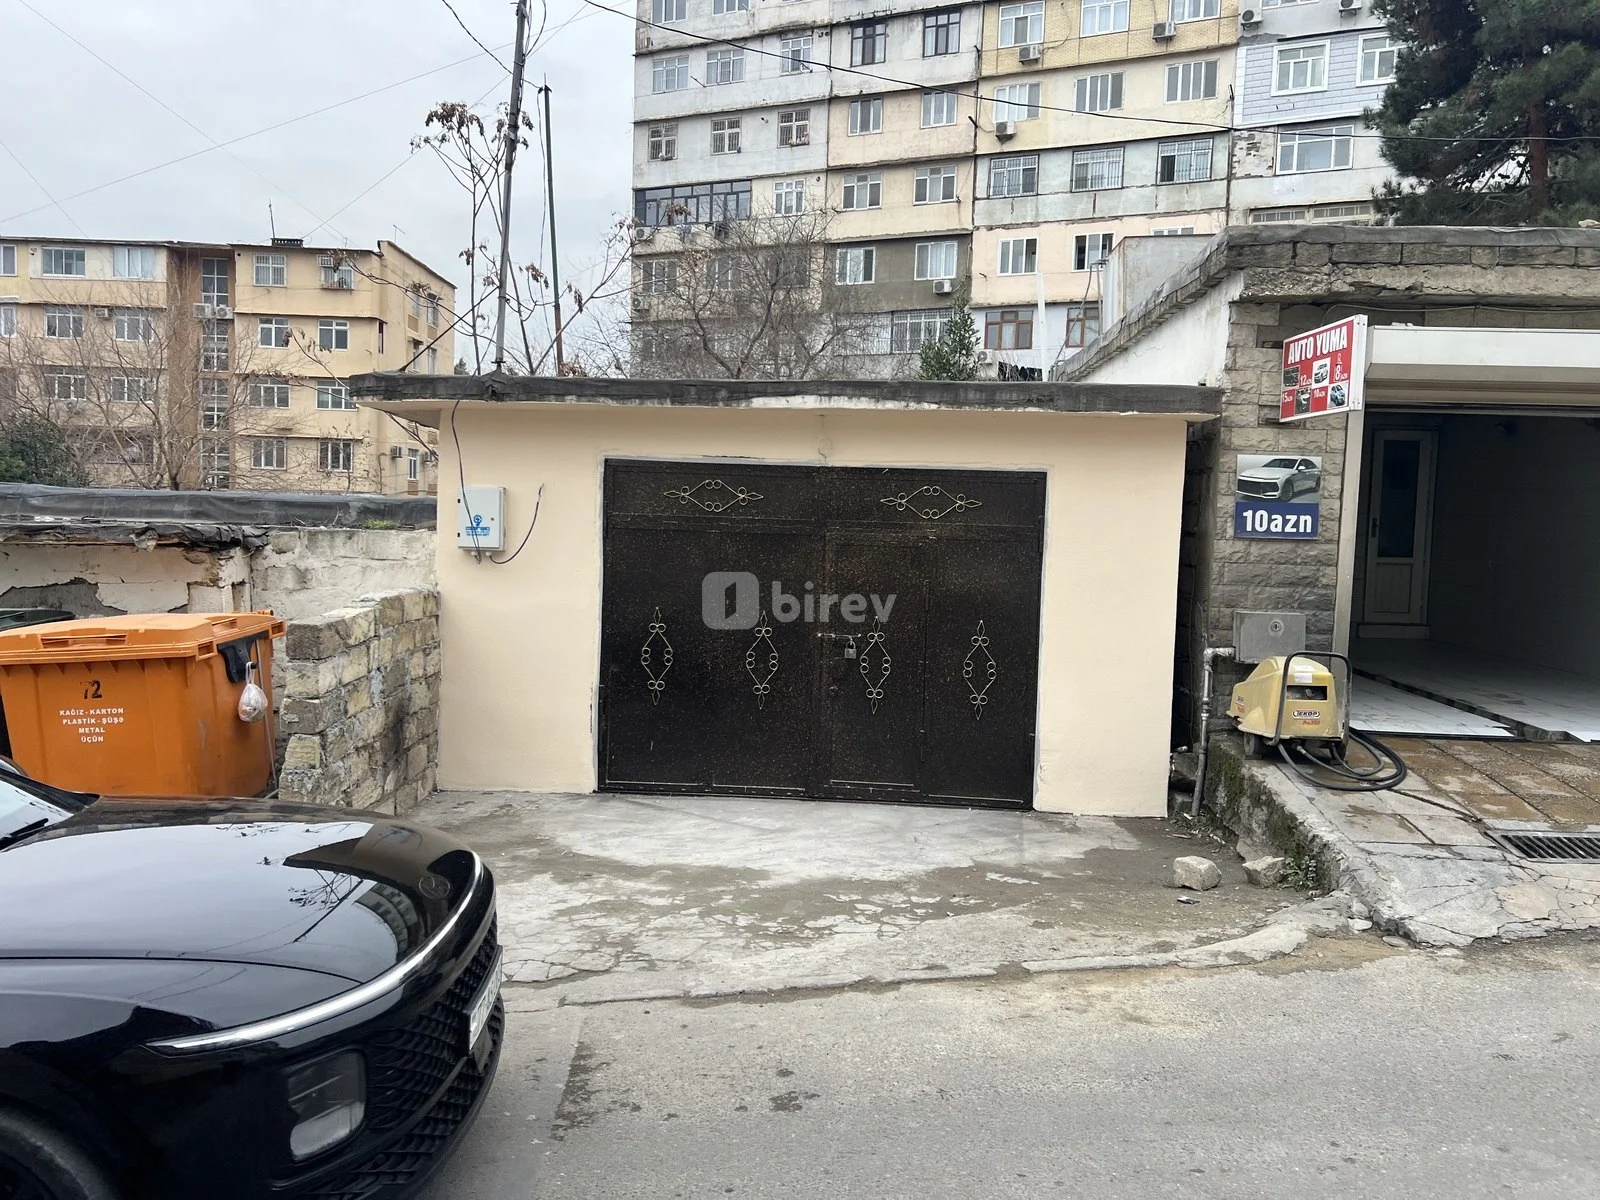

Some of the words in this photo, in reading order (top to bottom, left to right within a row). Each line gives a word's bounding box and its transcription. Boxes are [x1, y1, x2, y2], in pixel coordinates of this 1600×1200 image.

[1287, 336, 1314, 365] AVTO
[1316, 325, 1348, 357] YUMA
[1242, 509, 1312, 533] 10azn
[80, 680, 103, 700] 72
[59, 708, 85, 716] KAĞIZ
[89, 707, 124, 715] KARTON
[62, 717, 96, 725] PLASTİK
[80, 735, 104, 743] ÜÇÜN
